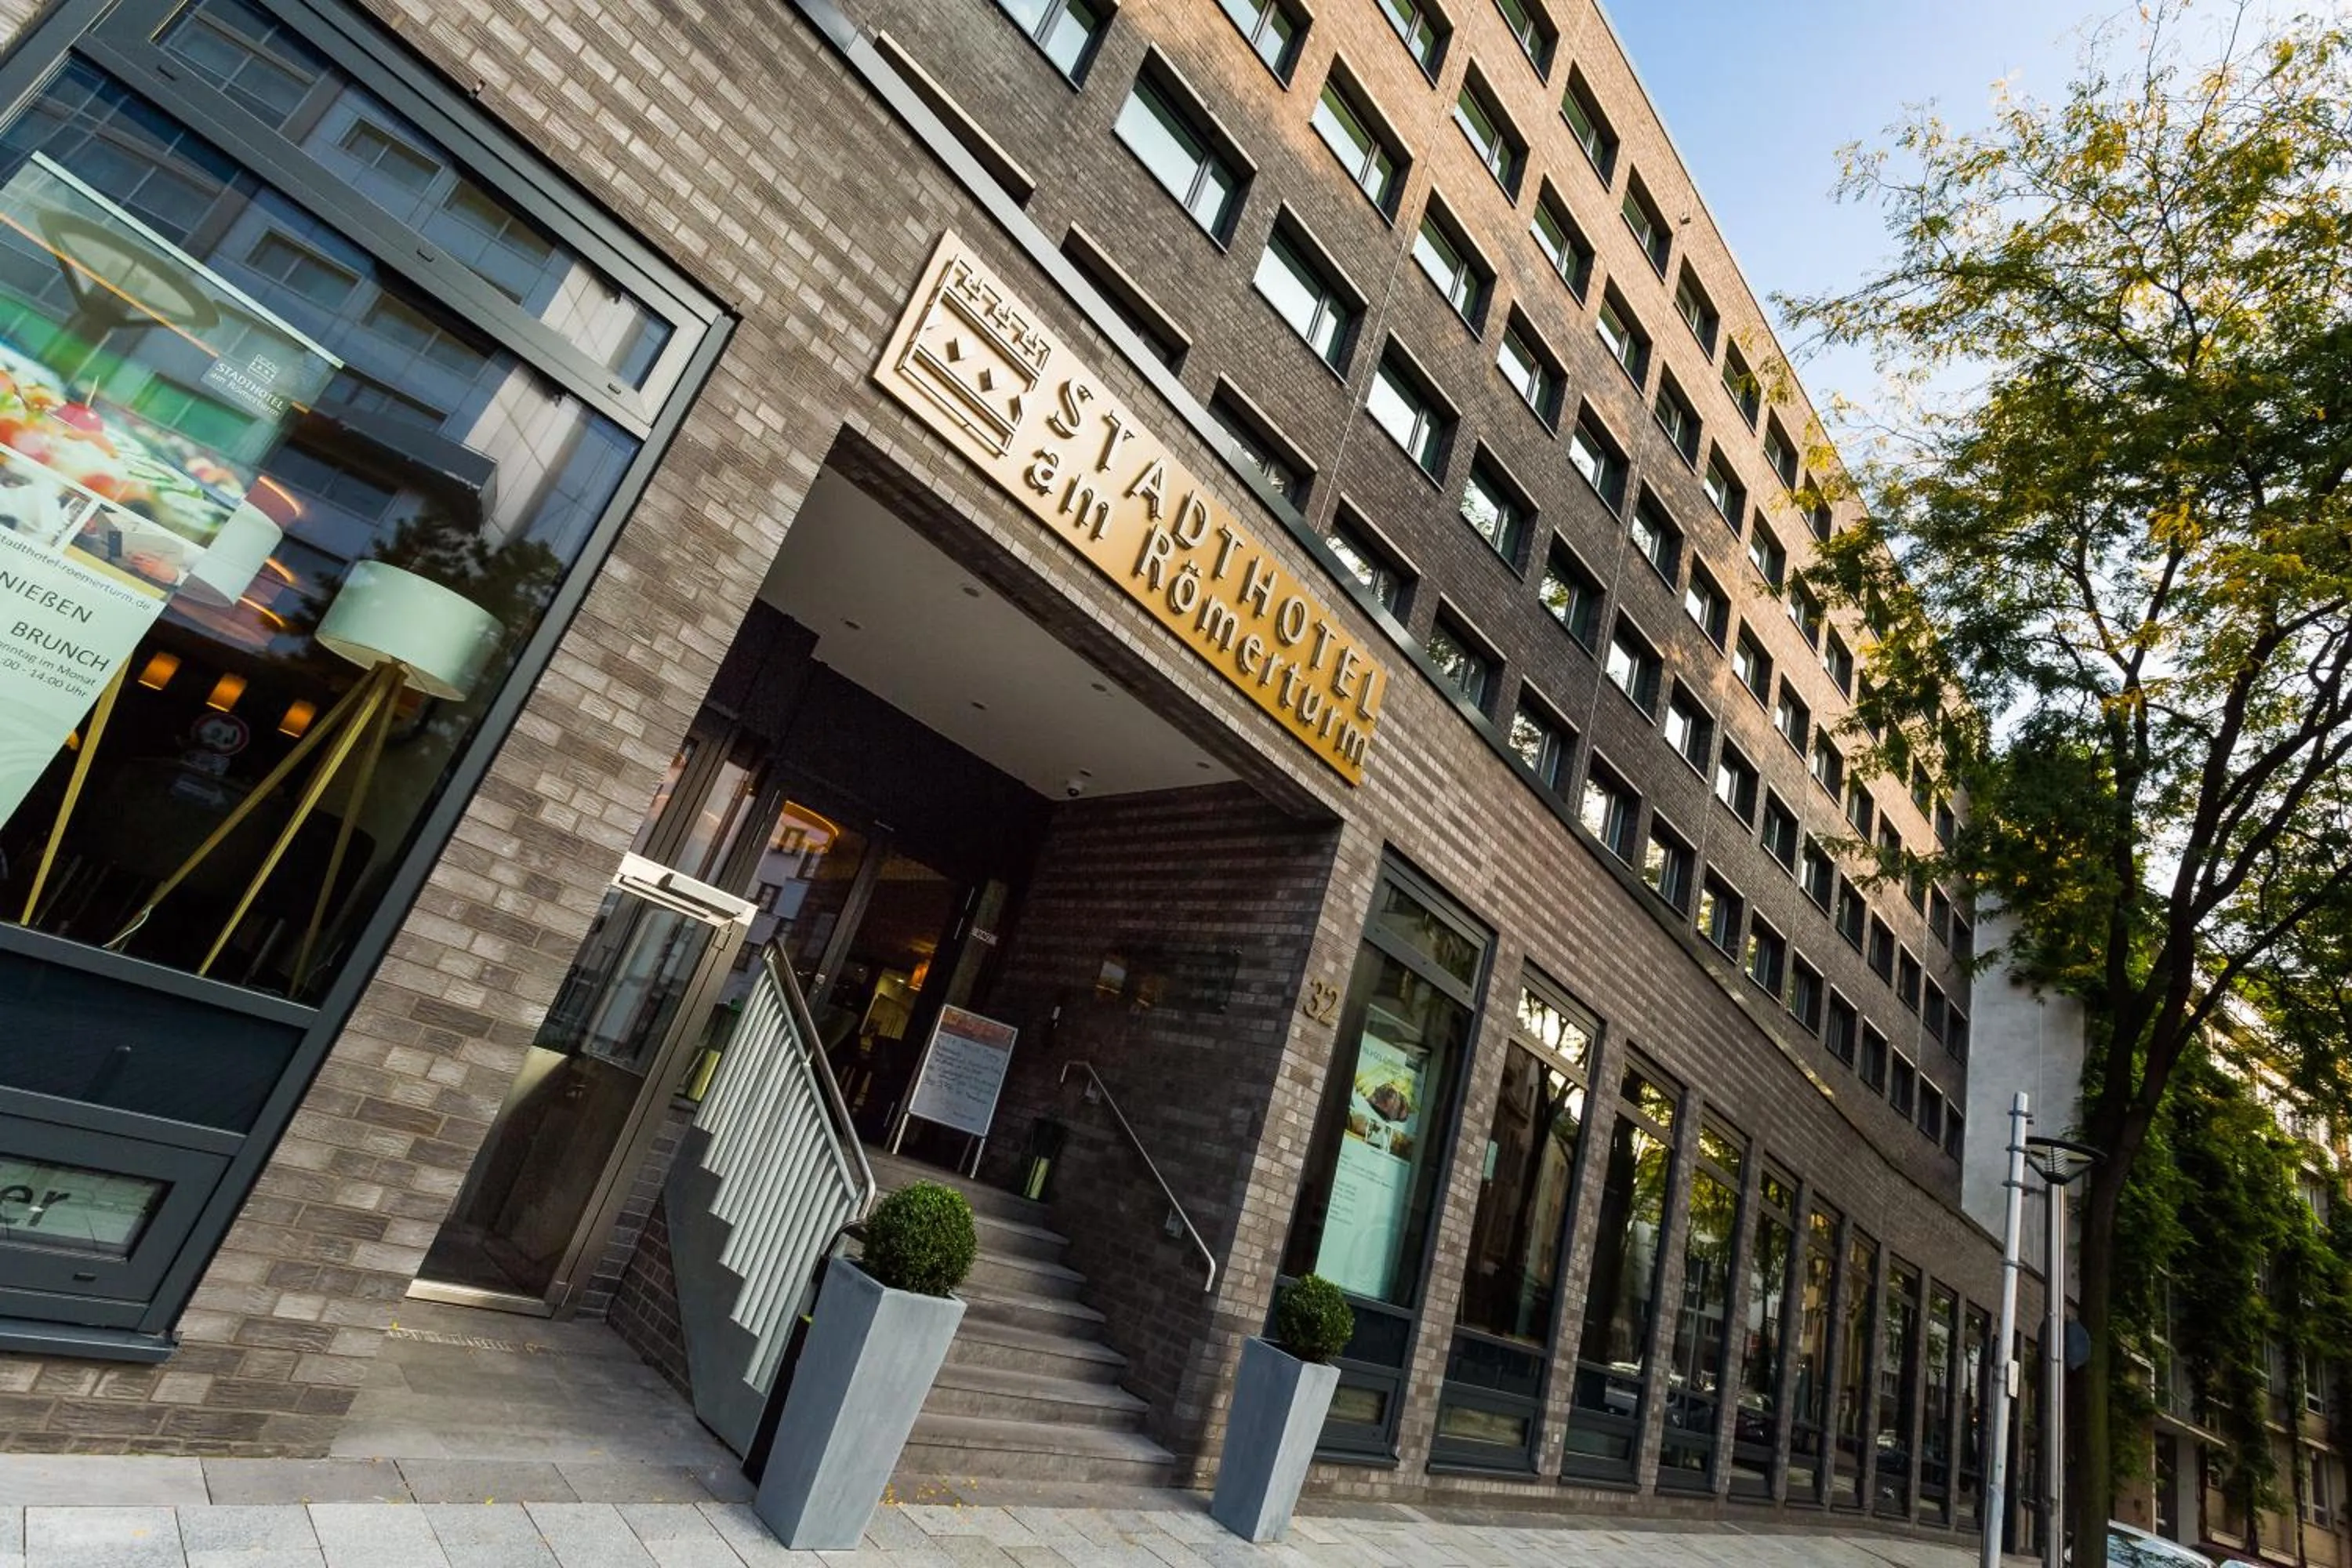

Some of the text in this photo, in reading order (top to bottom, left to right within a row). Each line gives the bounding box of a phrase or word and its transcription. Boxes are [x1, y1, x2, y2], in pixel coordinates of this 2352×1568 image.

[215, 362, 283, 410] STADTHOTEL
[0, 533, 151, 611] tadthotel-roemerturm.de
[1044, 376, 1381, 723] STADTHOTEL
[1022, 444, 1370, 770] am Römerturm
[10, 621, 111, 672] BRUNCH
[38, 658, 55, 670] im
[56, 664, 96, 687] Monat
[65, 683, 88, 698] Uhr
[1303, 977, 1339, 1029] 32
